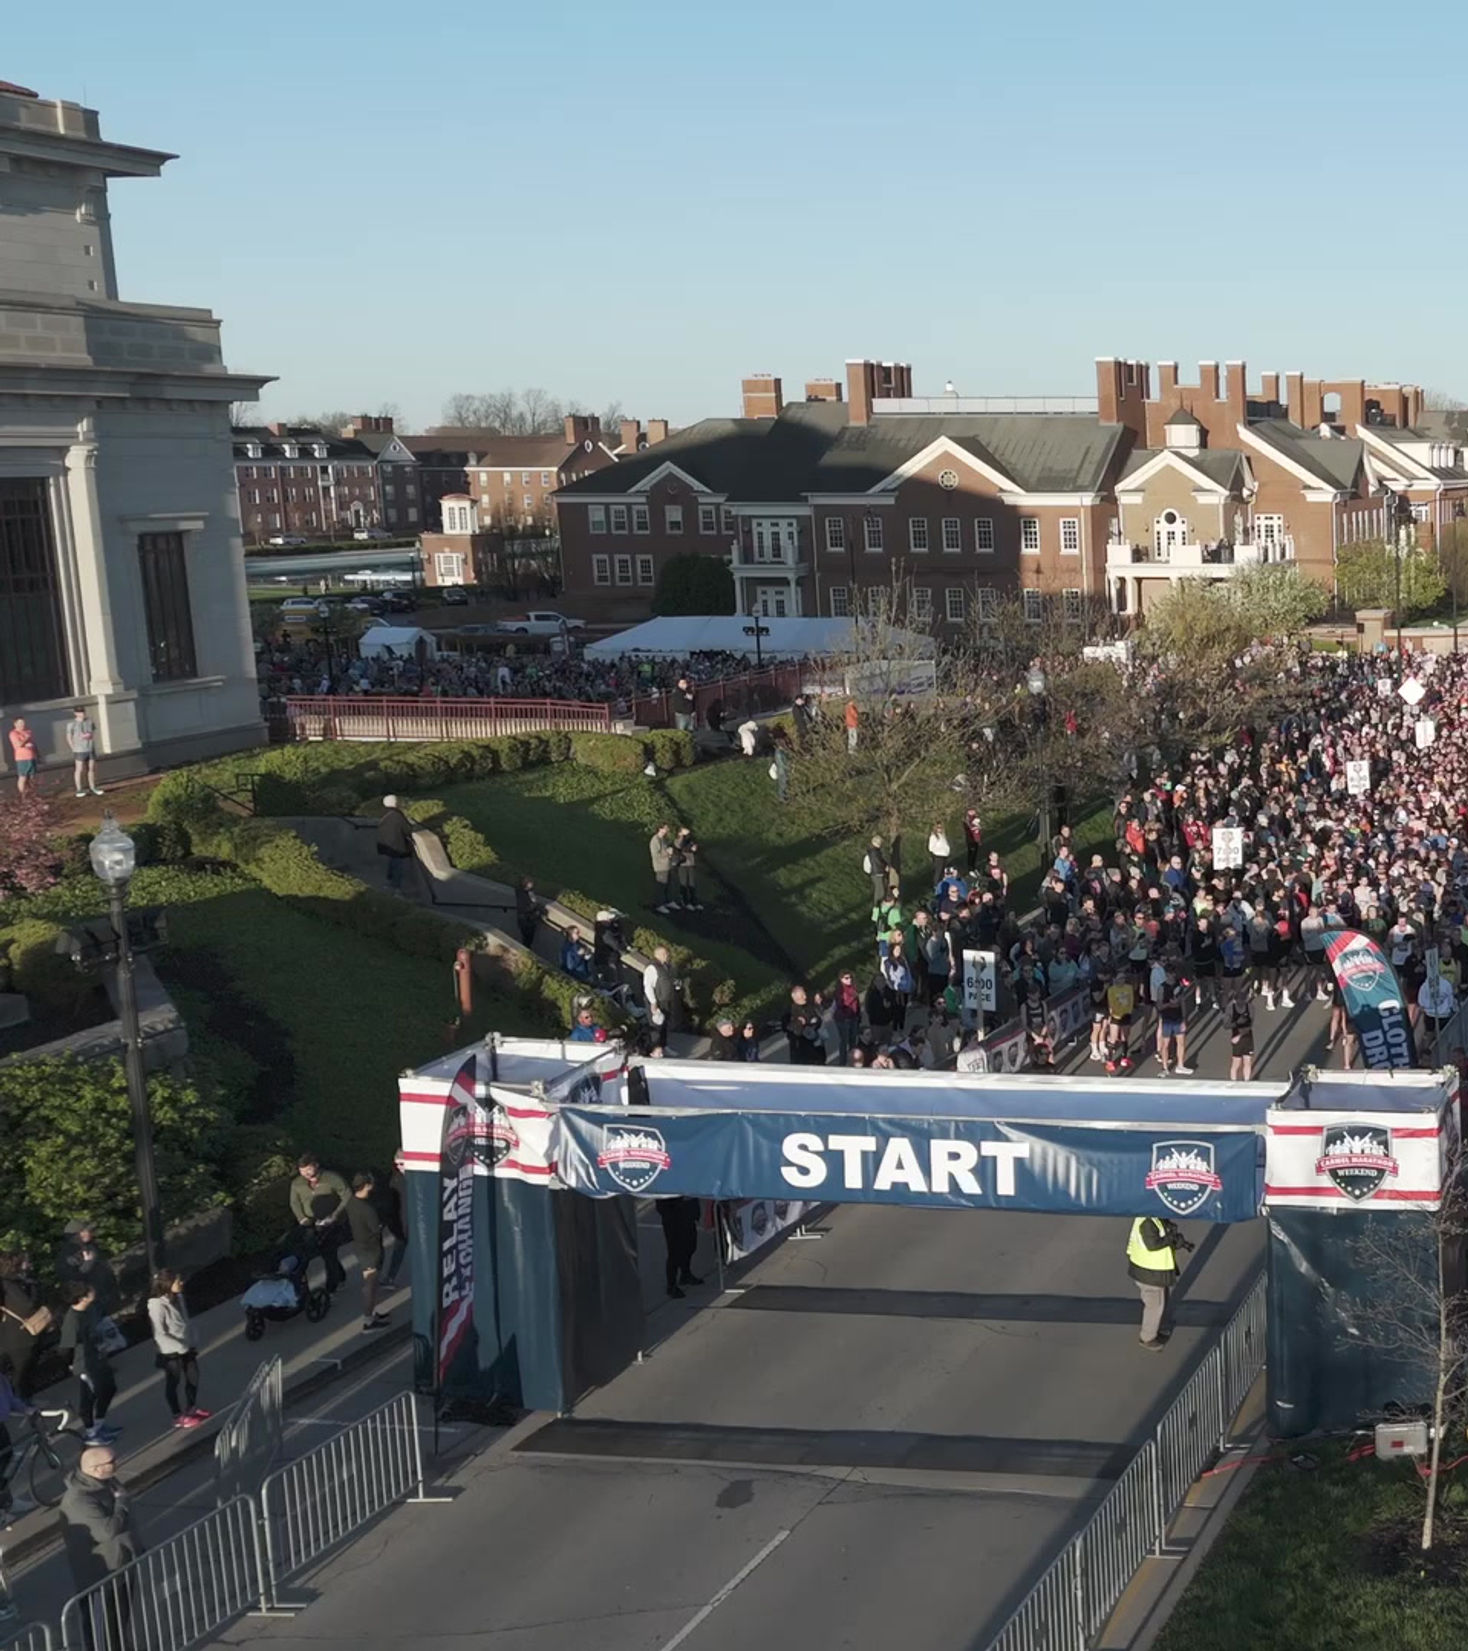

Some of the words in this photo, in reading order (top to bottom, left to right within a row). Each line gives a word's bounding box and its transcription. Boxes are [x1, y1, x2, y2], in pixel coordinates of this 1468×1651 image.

[780, 1132, 1029, 1195] START
[1320, 1156, 1349, 1167] CARMEL
[1351, 1156, 1394, 1167] MARATHON
[1337, 1168, 1378, 1177] WEEKEND
[442, 1177, 459, 1308] RELAY
